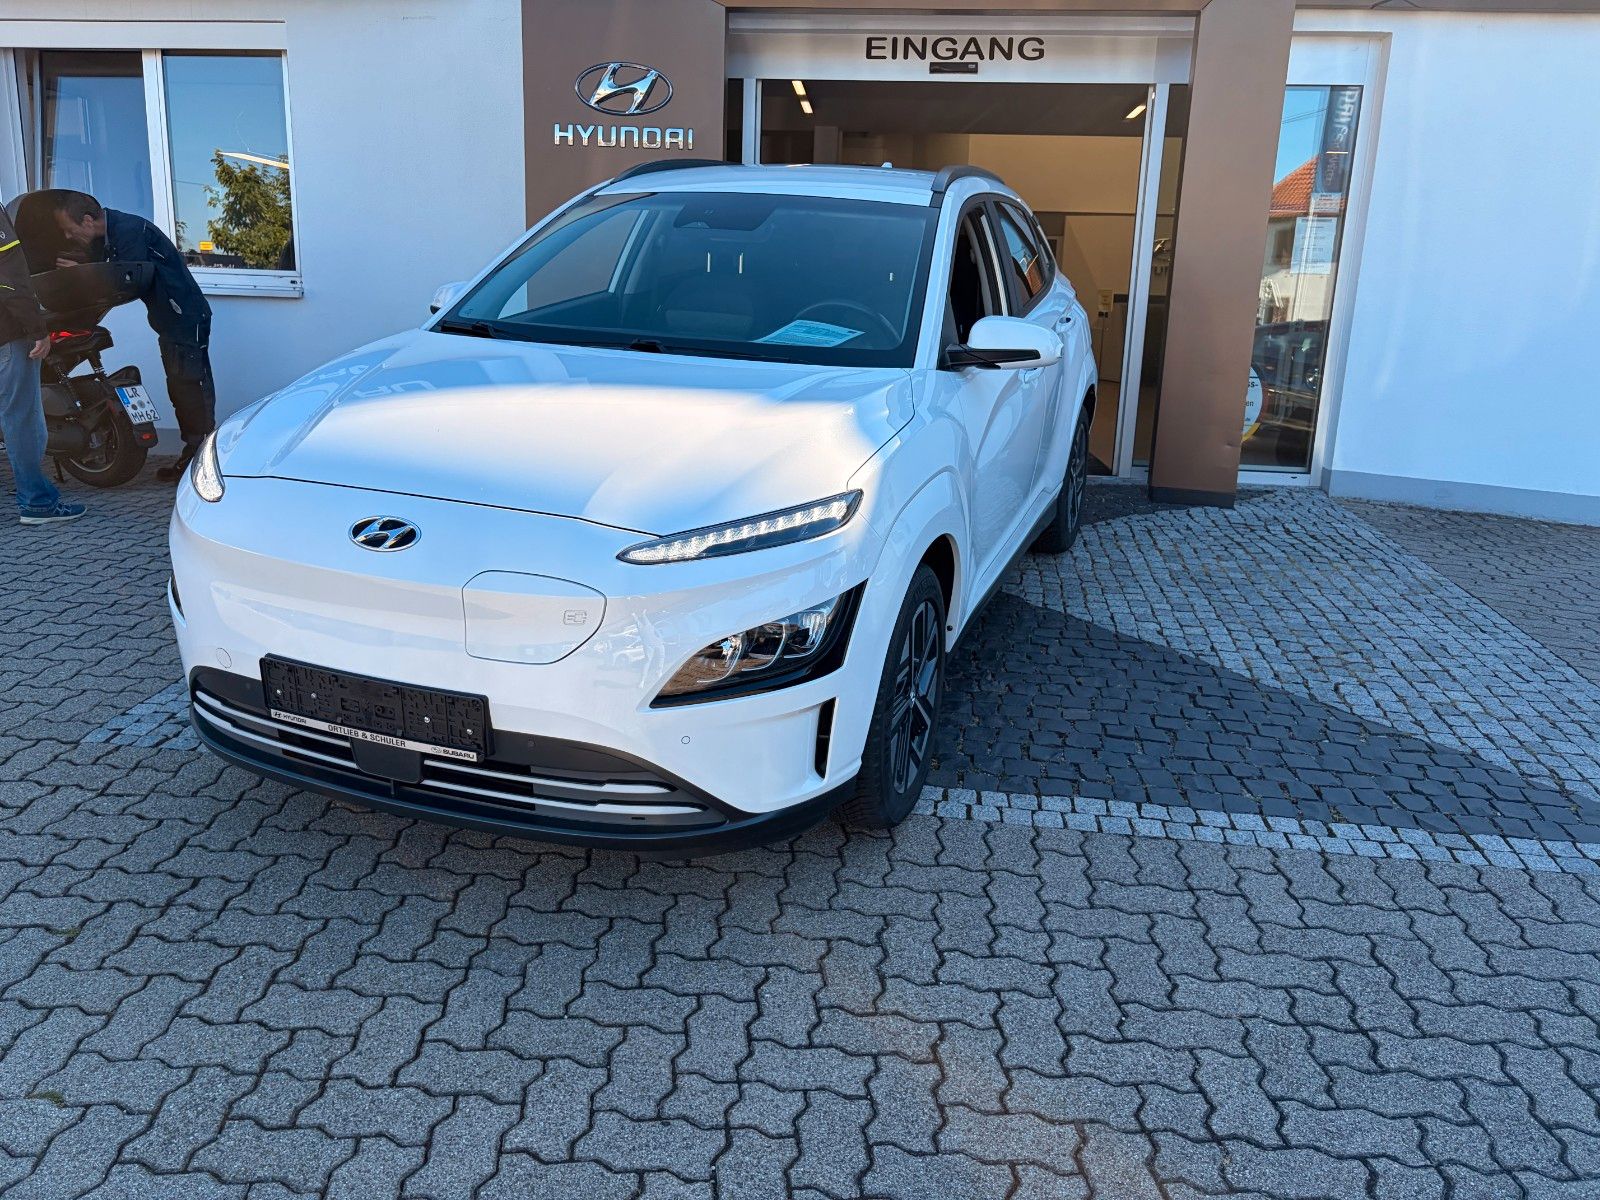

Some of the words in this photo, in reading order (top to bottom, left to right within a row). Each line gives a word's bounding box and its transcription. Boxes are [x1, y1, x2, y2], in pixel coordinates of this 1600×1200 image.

[866, 36, 1045, 61] EINGANG
[554, 123, 694, 150] HYUNDAI
[125, 387, 140, 398] LR
[283, 714, 307, 724] HYUNDAI
[327, 724, 359, 738] ORTLIEB
[442, 748, 475, 760] SUBARU
